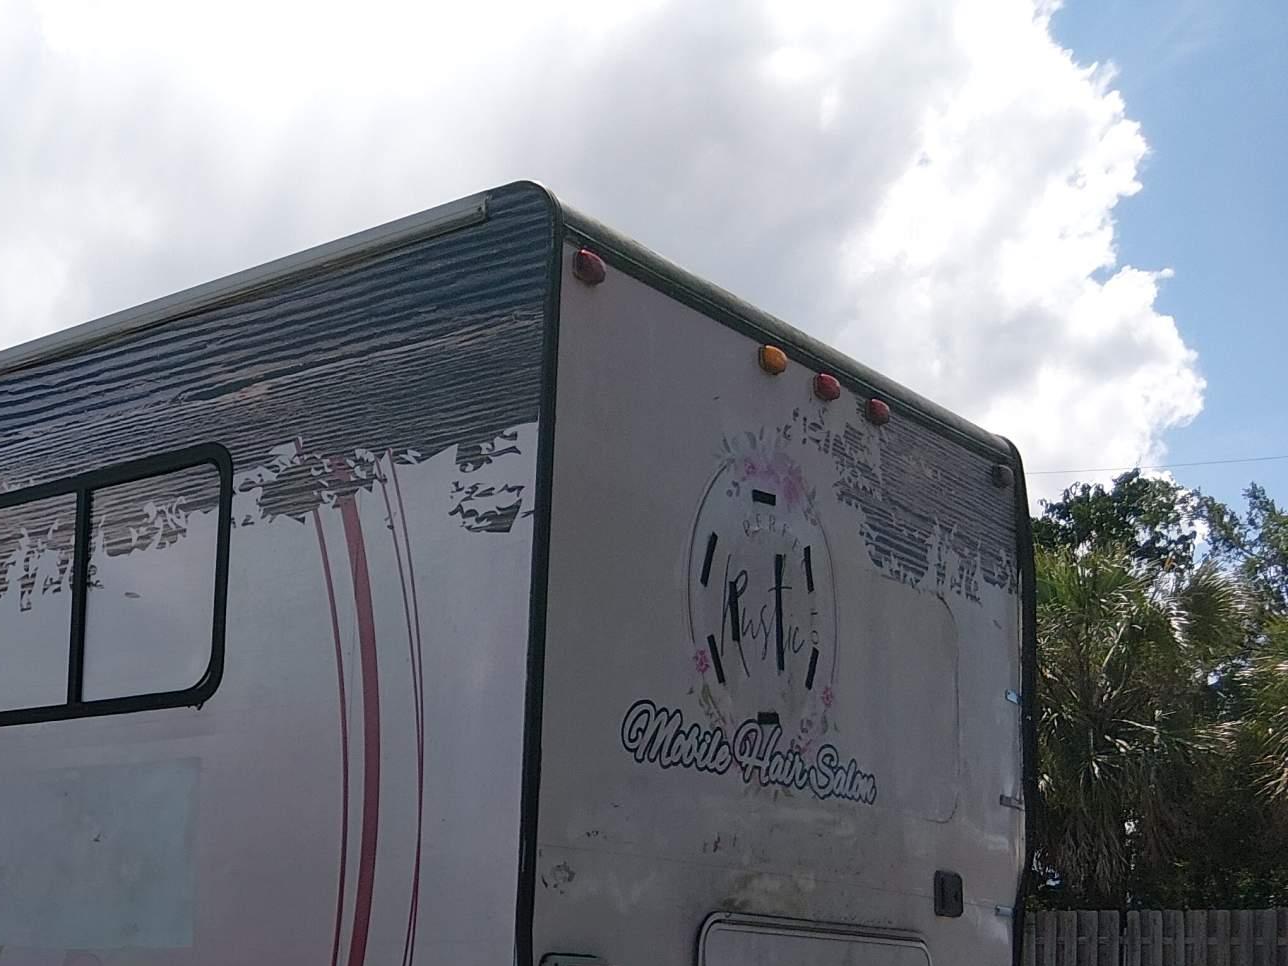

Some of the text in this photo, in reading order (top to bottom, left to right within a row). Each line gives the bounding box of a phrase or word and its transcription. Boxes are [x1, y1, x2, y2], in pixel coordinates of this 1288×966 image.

[622, 698, 878, 806] Mobile Hair Salon
